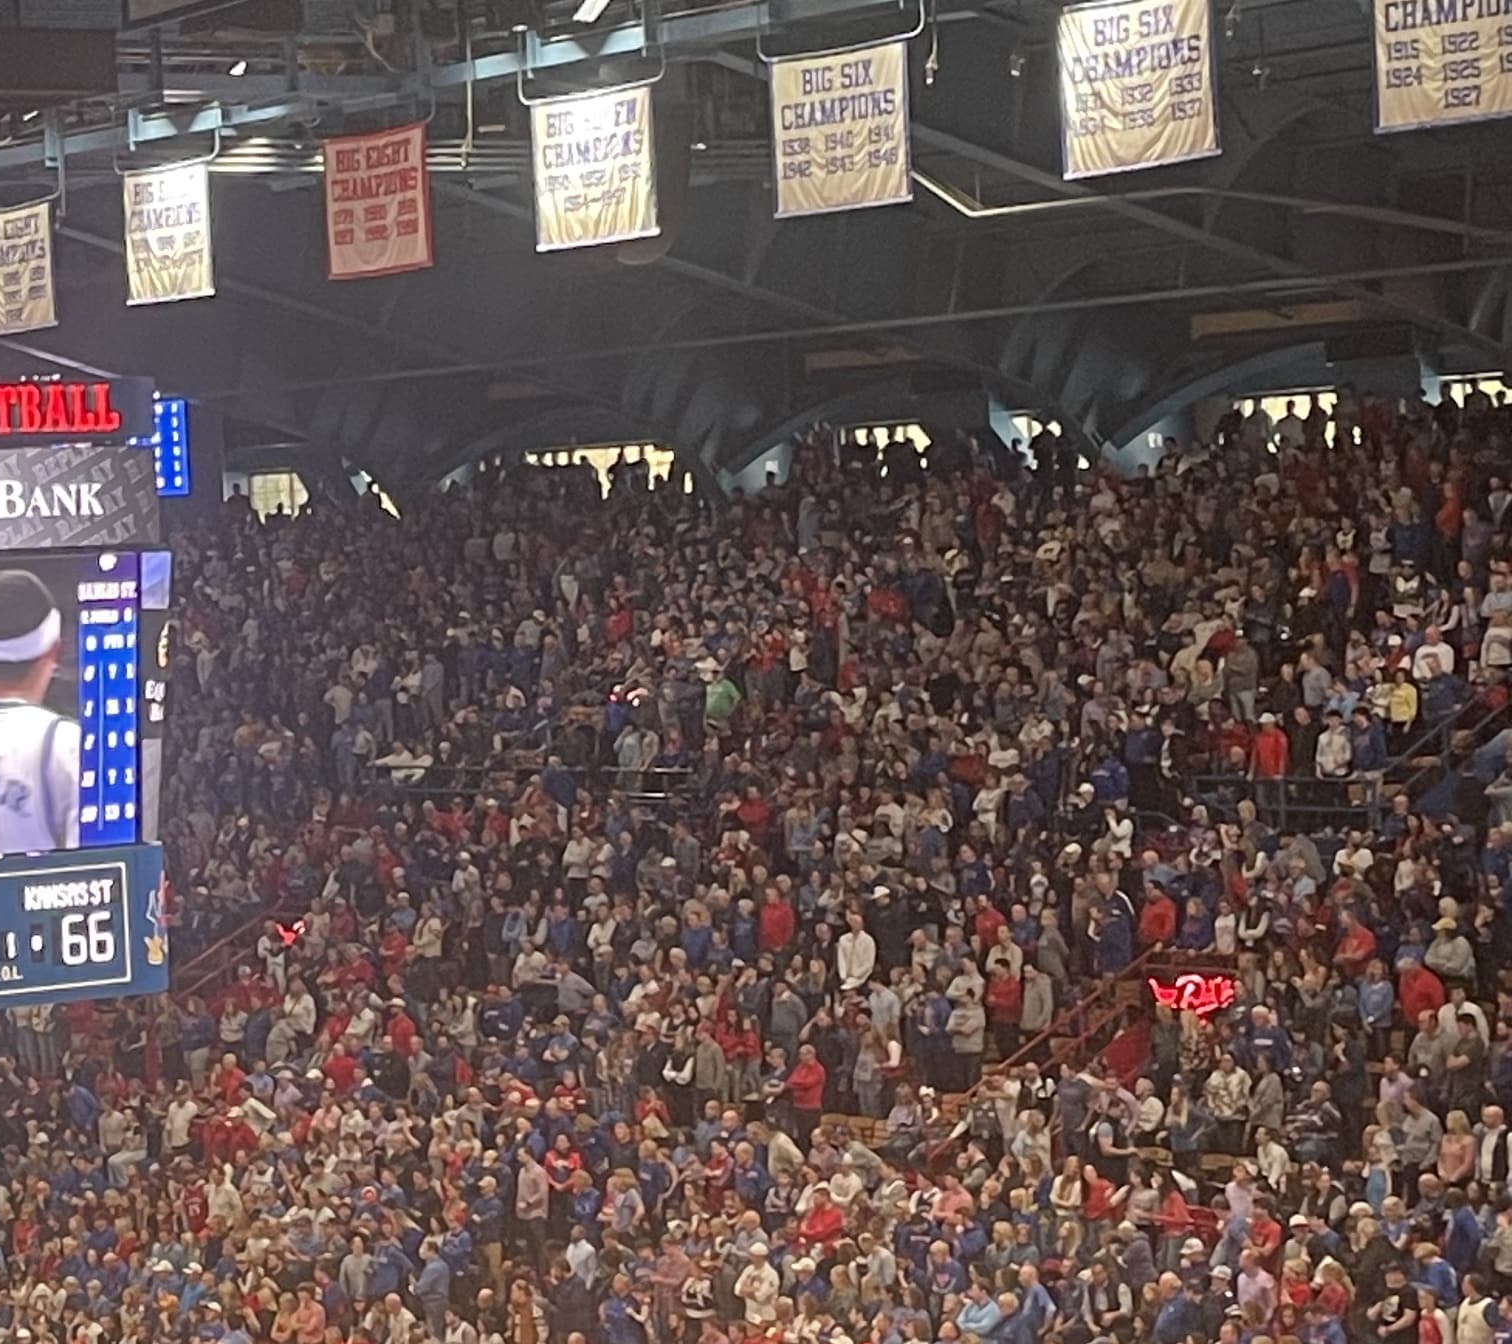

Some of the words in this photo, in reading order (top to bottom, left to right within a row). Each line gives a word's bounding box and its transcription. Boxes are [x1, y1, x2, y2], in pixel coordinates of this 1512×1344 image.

[1093, 14, 1129, 46] BIG
[1138, 5, 1173, 38] SIX
[1387, 39, 1420, 62] 1915
[1441, 31, 1479, 54] 1922
[1497, 25, 1512, 47] 19
[802, 66, 833, 95] BIG
[841, 58, 872, 88] SIX
[1072, 34, 1200, 84] CHAMPIONS
[1386, 66, 1422, 89] 1924
[1442, 58, 1481, 82] 1925
[781, 88, 895, 130] CHAMPIONS
[1444, 85, 1481, 109] 1927
[546, 111, 573, 138] BIG
[336, 148, 360, 173] BIG
[366, 138, 411, 169] EIGHT
[332, 167, 418, 203] CHAMPIONS
[24, 882, 89, 911] KANSAS
[60, 911, 115, 966] 66
